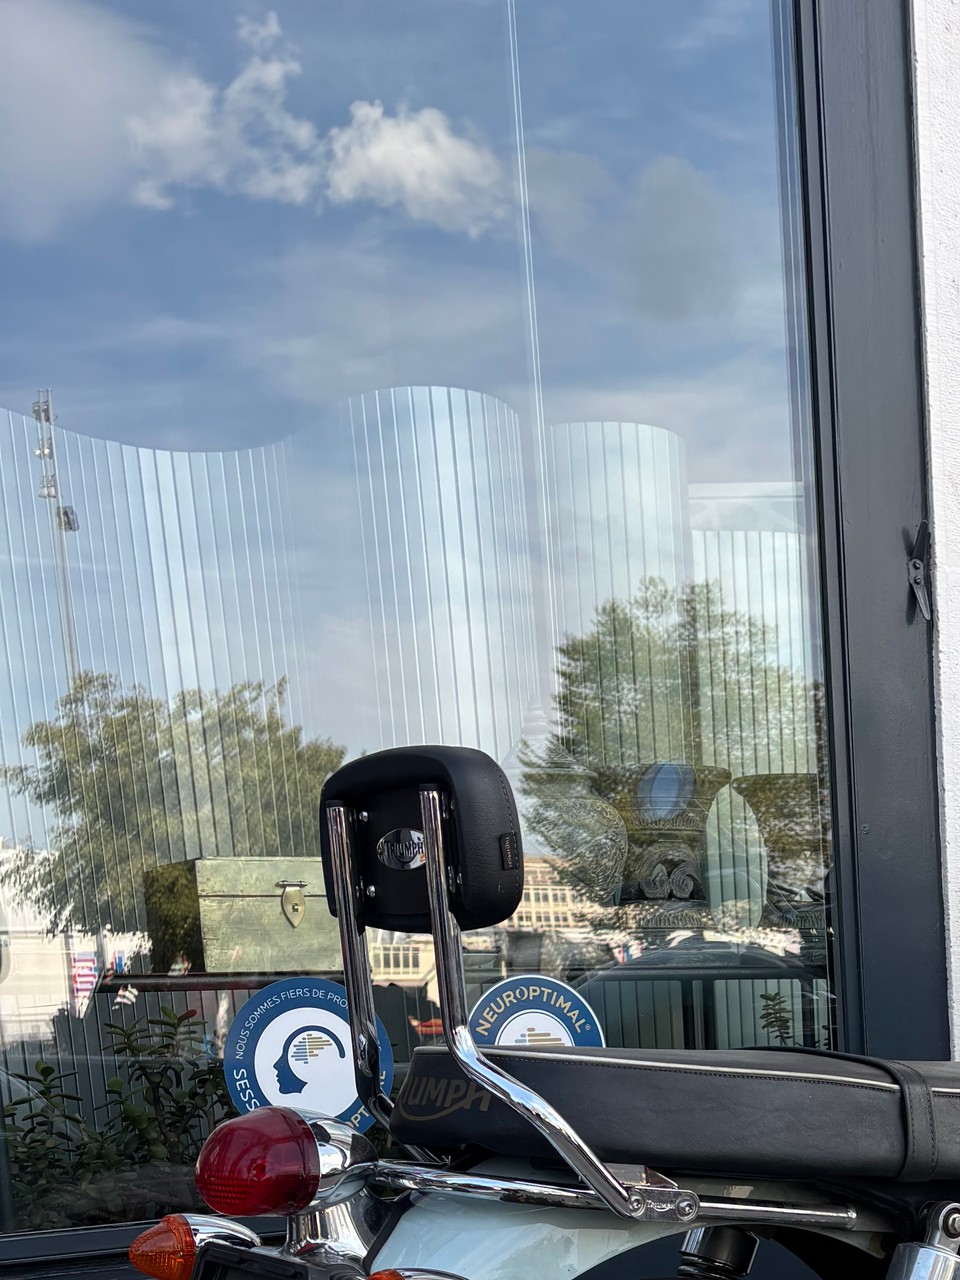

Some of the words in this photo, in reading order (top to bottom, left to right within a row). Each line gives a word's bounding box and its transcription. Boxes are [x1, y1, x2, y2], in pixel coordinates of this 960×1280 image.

[384, 841, 425, 862] TRIUMPH
[235, 1030, 250, 1060] NOUS
[246, 996, 281, 1030] SOMMES
[280, 988, 310, 1001] FIERS
[312, 989, 326, 998] DE
[233, 1068, 261, 1111] SESS
[399, 1076, 492, 1121] IUMPH
